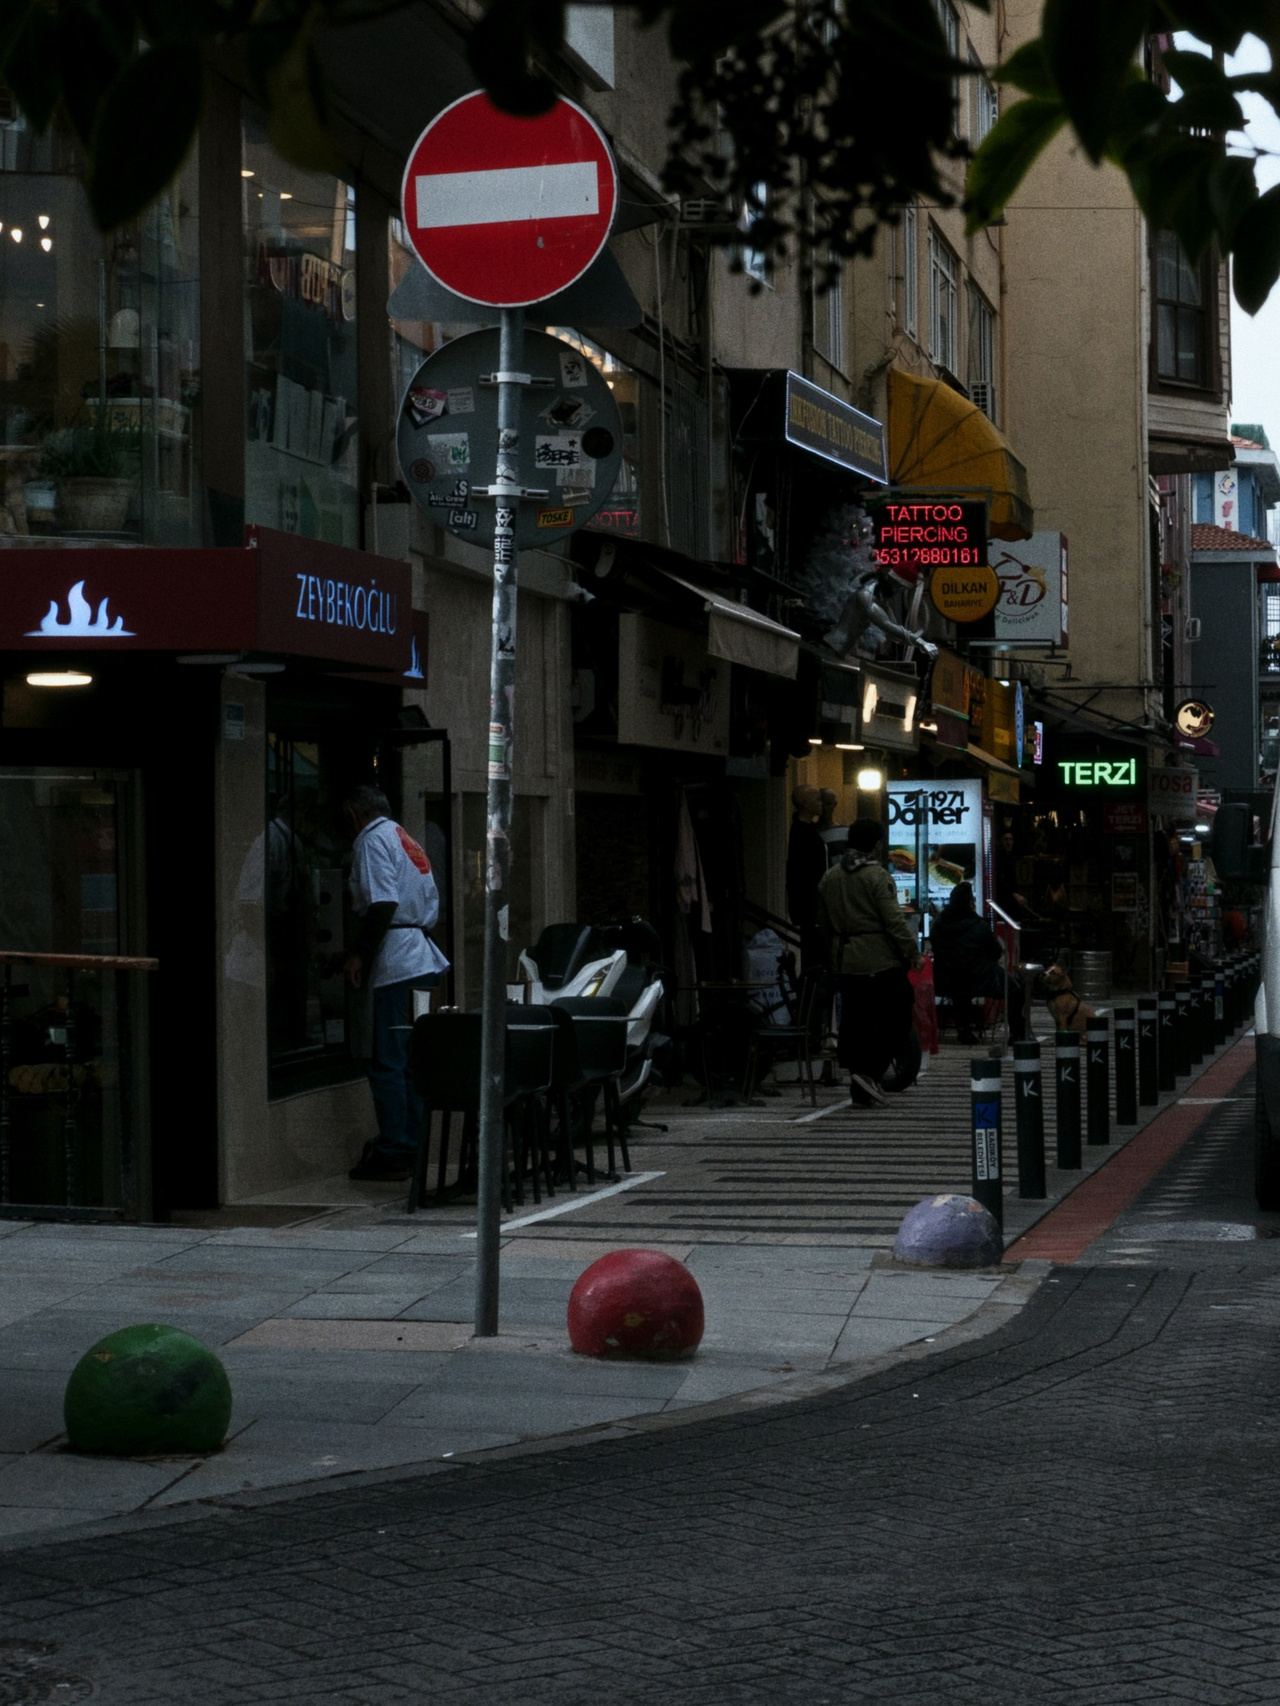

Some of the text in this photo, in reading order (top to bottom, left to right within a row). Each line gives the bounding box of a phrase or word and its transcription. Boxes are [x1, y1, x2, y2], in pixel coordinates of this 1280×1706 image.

[541, 511, 570, 523] TOSKE
[886, 505, 963, 521] TATTOO
[296, 573, 396, 635] ZEYBEKOĞLU
[1058, 758, 1136, 785] TERZİ
[1151, 774, 1192, 793] rosa
[929, 791, 964, 807] 1971
[1114, 805, 1135, 814] JET
[1141, 1024, 1153, 1037] K
[1120, 1035, 1132, 1050] K
[1091, 1048, 1105, 1064] K
[1061, 1066, 1076, 1082] K
[1023, 1079, 1039, 1097] K
